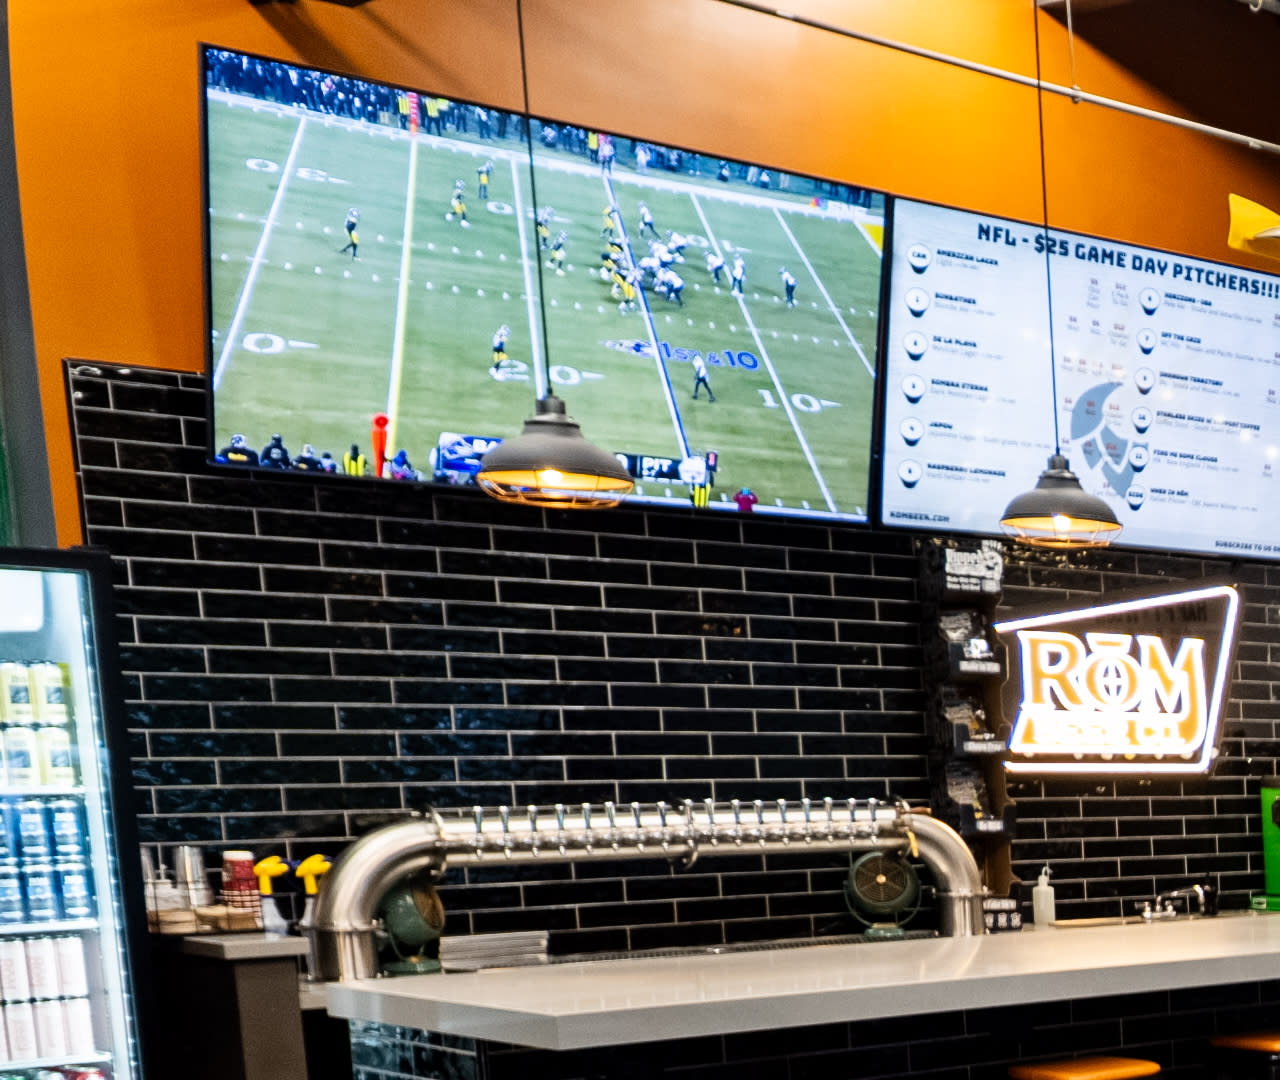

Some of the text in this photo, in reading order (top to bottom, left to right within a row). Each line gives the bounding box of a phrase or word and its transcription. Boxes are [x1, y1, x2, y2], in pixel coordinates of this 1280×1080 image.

[936, 248, 999, 266] AMERICAN LAGER
[978, 223, 1017, 247] NFL
[1034, 232, 1069, 257] $25
[1074, 242, 1126, 269] GAME
[1132, 254, 1168, 279] DAY
[1172, 262, 1280, 300] PITCHERS!!!
[723, 349, 760, 370] 10
[757, 388, 823, 414] 10
